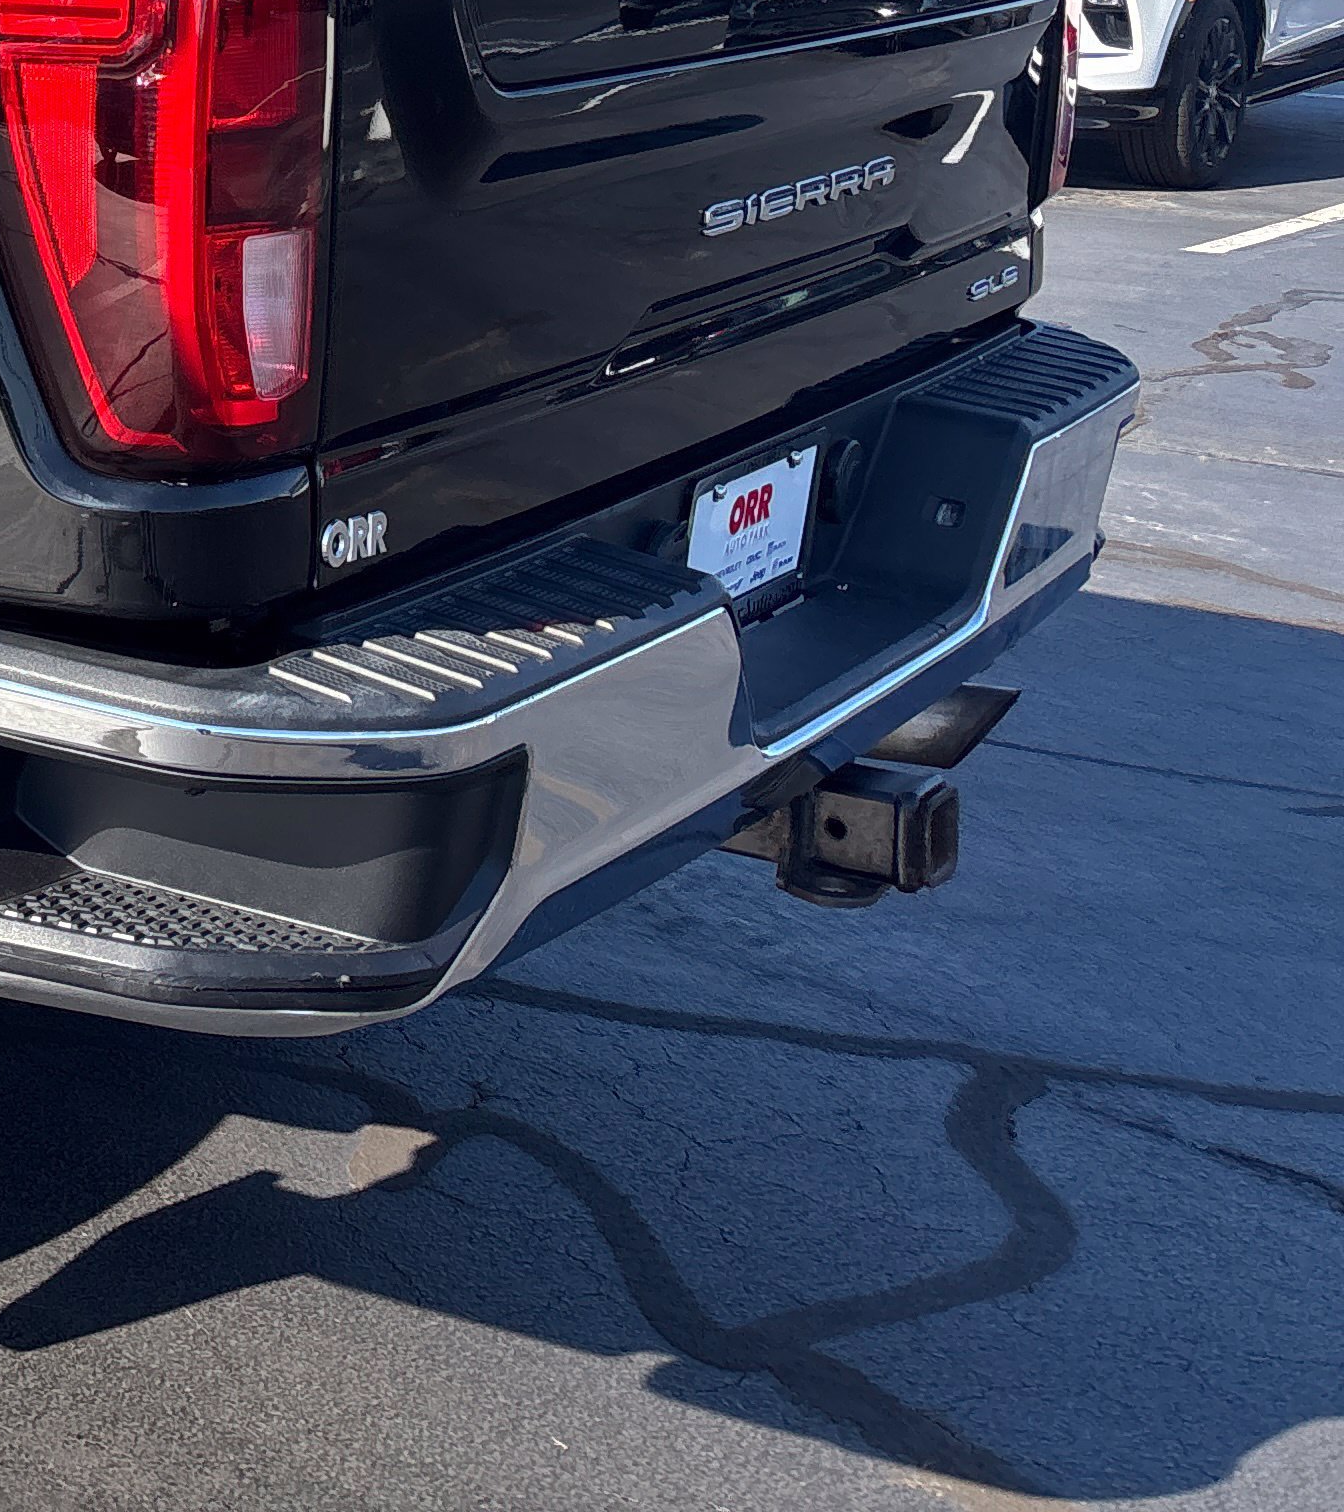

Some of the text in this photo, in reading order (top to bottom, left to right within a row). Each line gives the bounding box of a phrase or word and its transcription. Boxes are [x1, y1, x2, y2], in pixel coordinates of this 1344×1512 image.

[701, 155, 897, 237] SIERRA
[970, 265, 1019, 301] SLE
[729, 483, 772, 535] ORR
[321, 510, 388, 568] ORR
